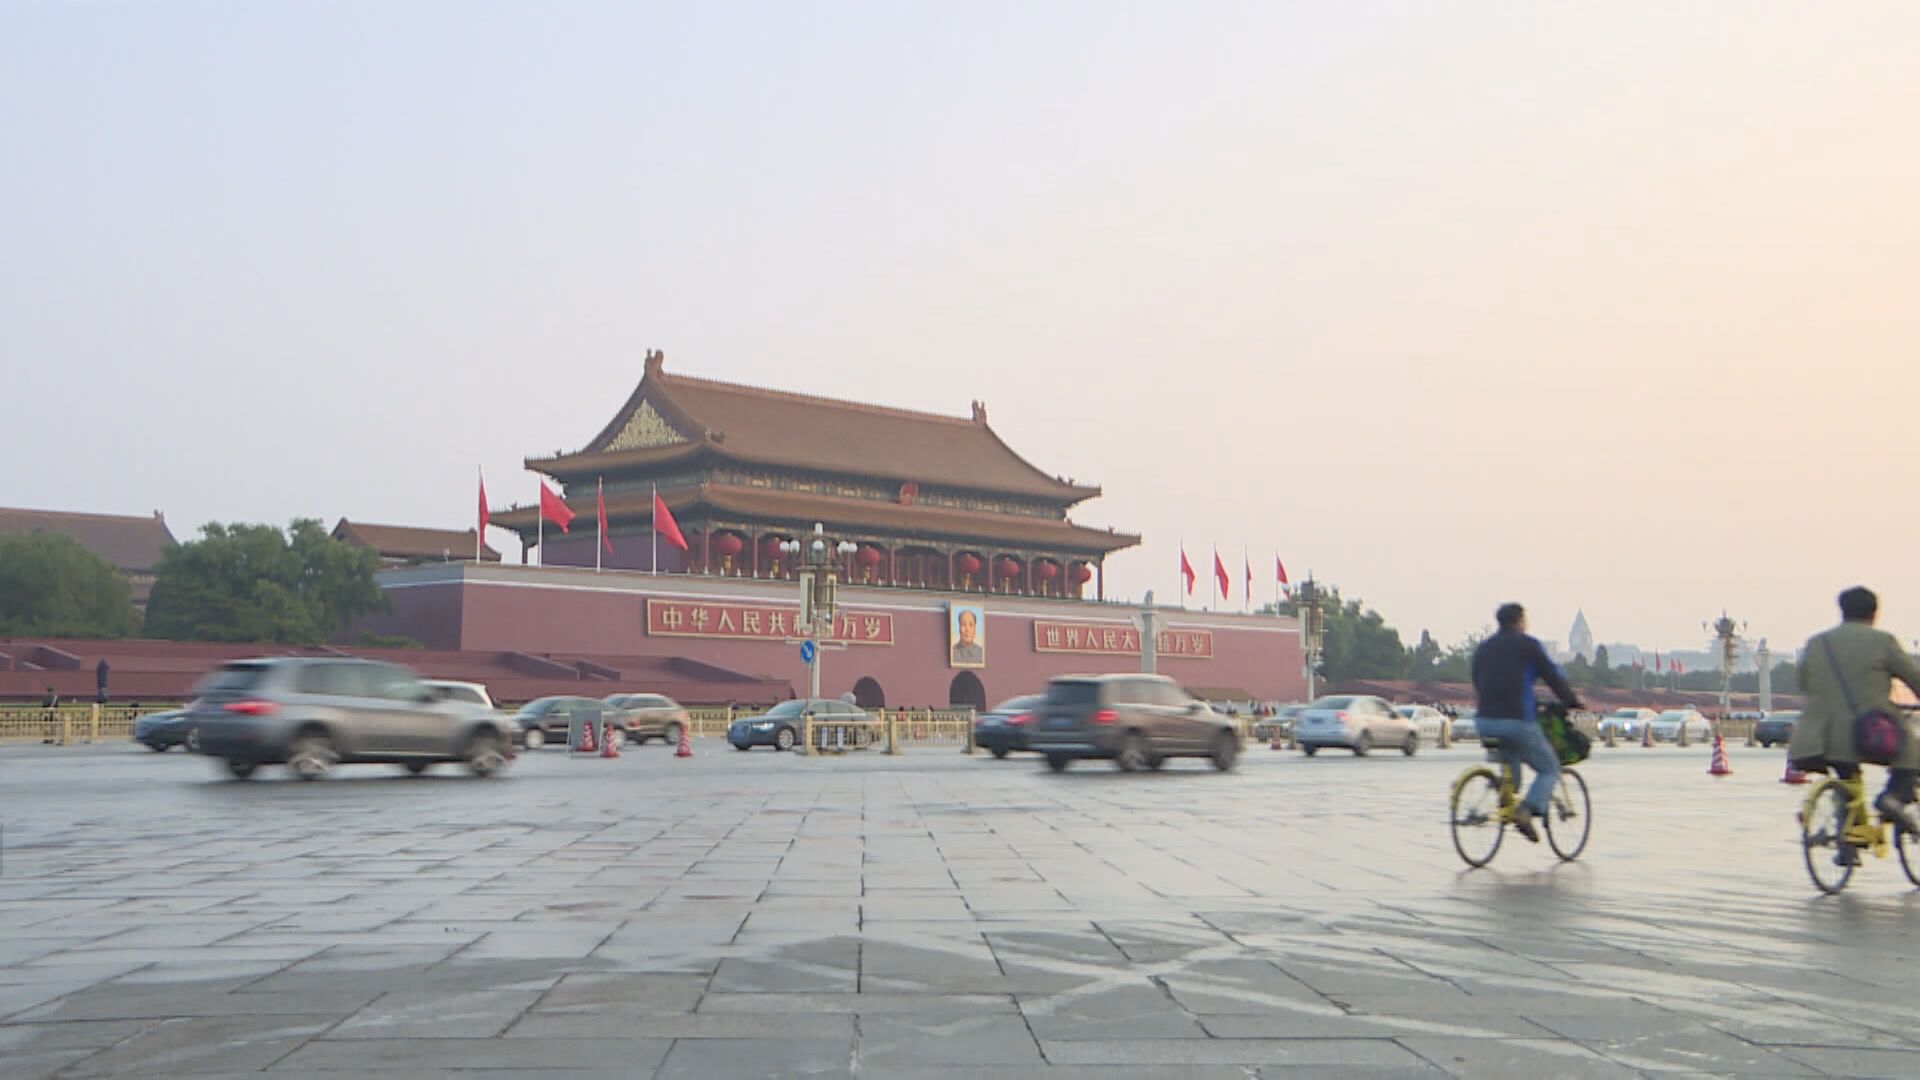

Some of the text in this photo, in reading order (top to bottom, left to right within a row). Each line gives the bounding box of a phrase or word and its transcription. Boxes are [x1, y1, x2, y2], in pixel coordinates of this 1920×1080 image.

[1046, 626, 1204, 653] 世界人民大结万岁
